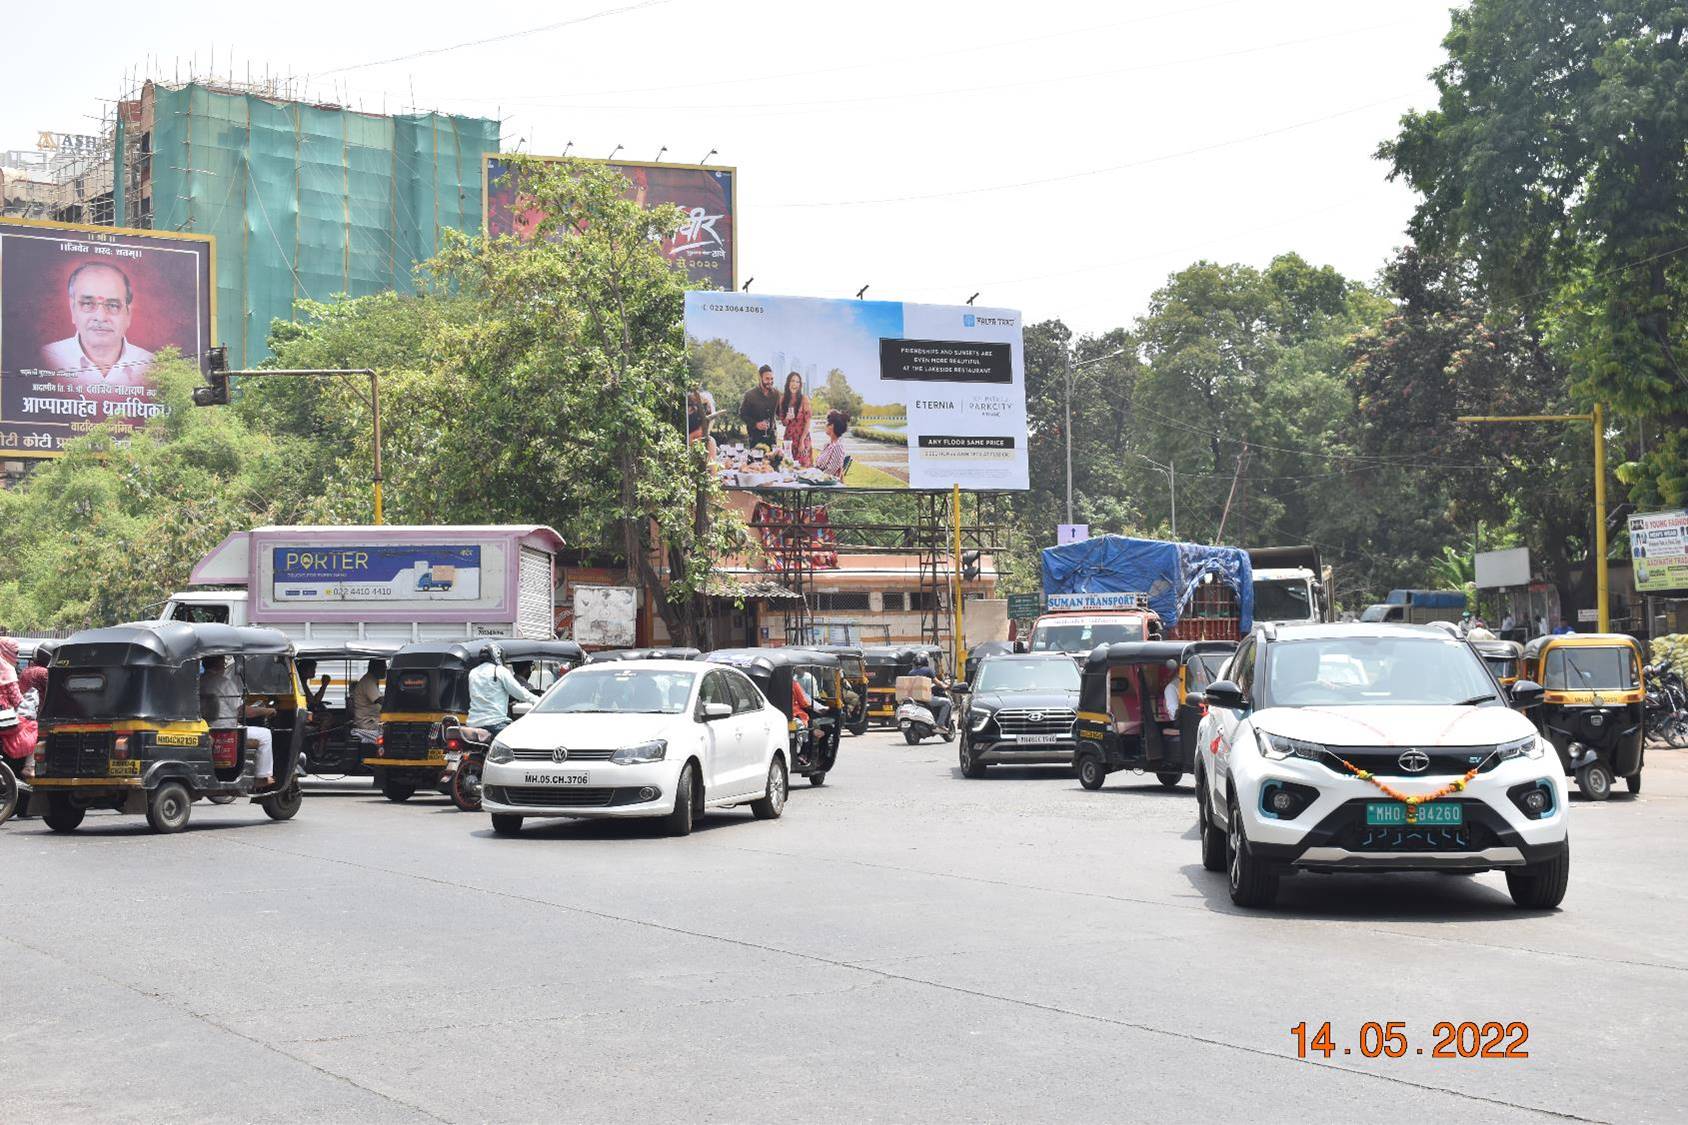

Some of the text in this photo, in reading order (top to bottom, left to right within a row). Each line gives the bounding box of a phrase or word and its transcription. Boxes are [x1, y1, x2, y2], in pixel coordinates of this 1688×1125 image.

[900, 347, 940, 356] FRIENDSHIPS
[940, 348, 953, 356] AND
[954, 349, 980, 357] SUNSETS
[913, 356, 931, 364] EVEN
[948, 358, 981, 366] BEAUTIFUL
[912, 365, 924, 373] THE
[924, 366, 953, 374] LAKESIDE
[953, 367, 992, 375] RESTAURANT
[22, 394, 98, 418] आप्पासाहेब
[915, 399, 955, 410] ETERNIA
[22, 432, 52, 449] कोटी
[927, 438, 1005, 448] ANY FLOOR SAME PRICE
[286, 551, 369, 570] PORTER
[350, 588, 371, 596] 4410
[372, 587, 392, 596] 4410
[1048, 597, 1084, 608] SUMAN
[1085, 596, 1136, 607] TRANSPORT
